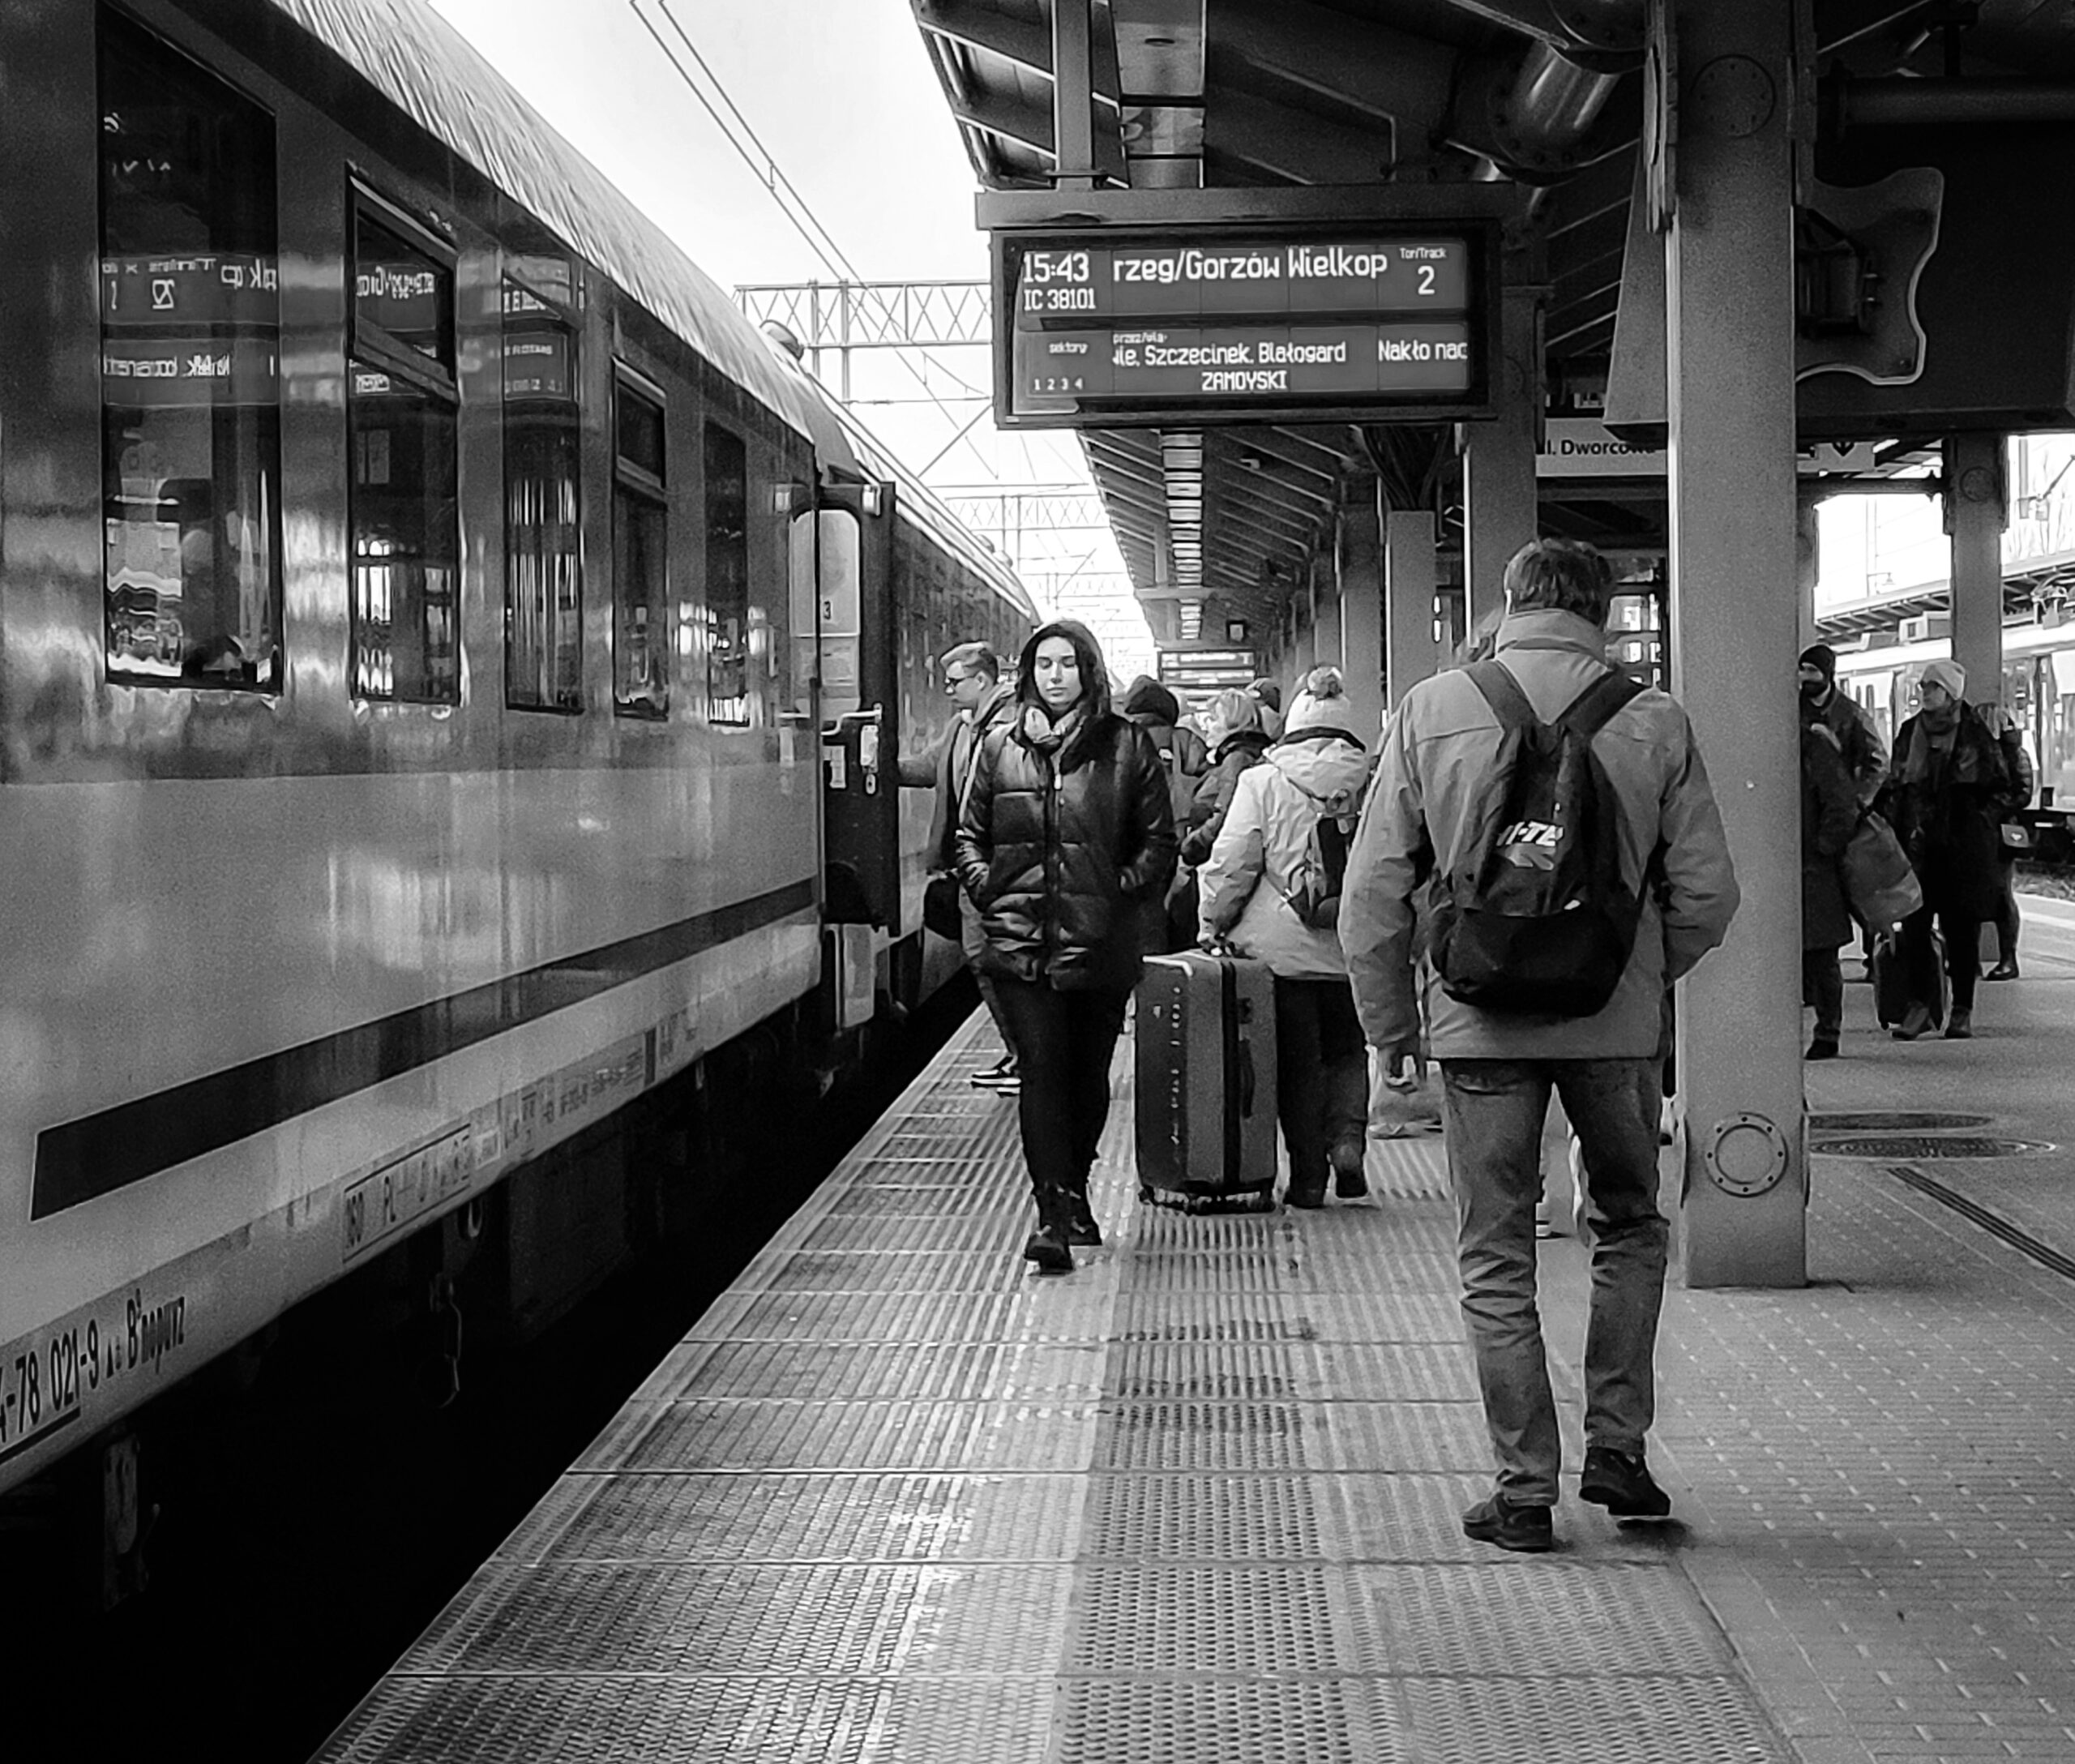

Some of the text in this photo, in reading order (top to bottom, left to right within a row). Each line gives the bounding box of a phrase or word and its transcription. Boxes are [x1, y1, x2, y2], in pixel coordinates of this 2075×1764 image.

[1024, 246, 1388, 282] 15:43 rzeg/Gorzów Wielkop
[1418, 265, 1435, 295] 2
[1024, 288, 1096, 310] IC 38101
[1201, 370, 1287, 392] ZAMOYSKI
[50, 1318, 99, 1411] 021-9
